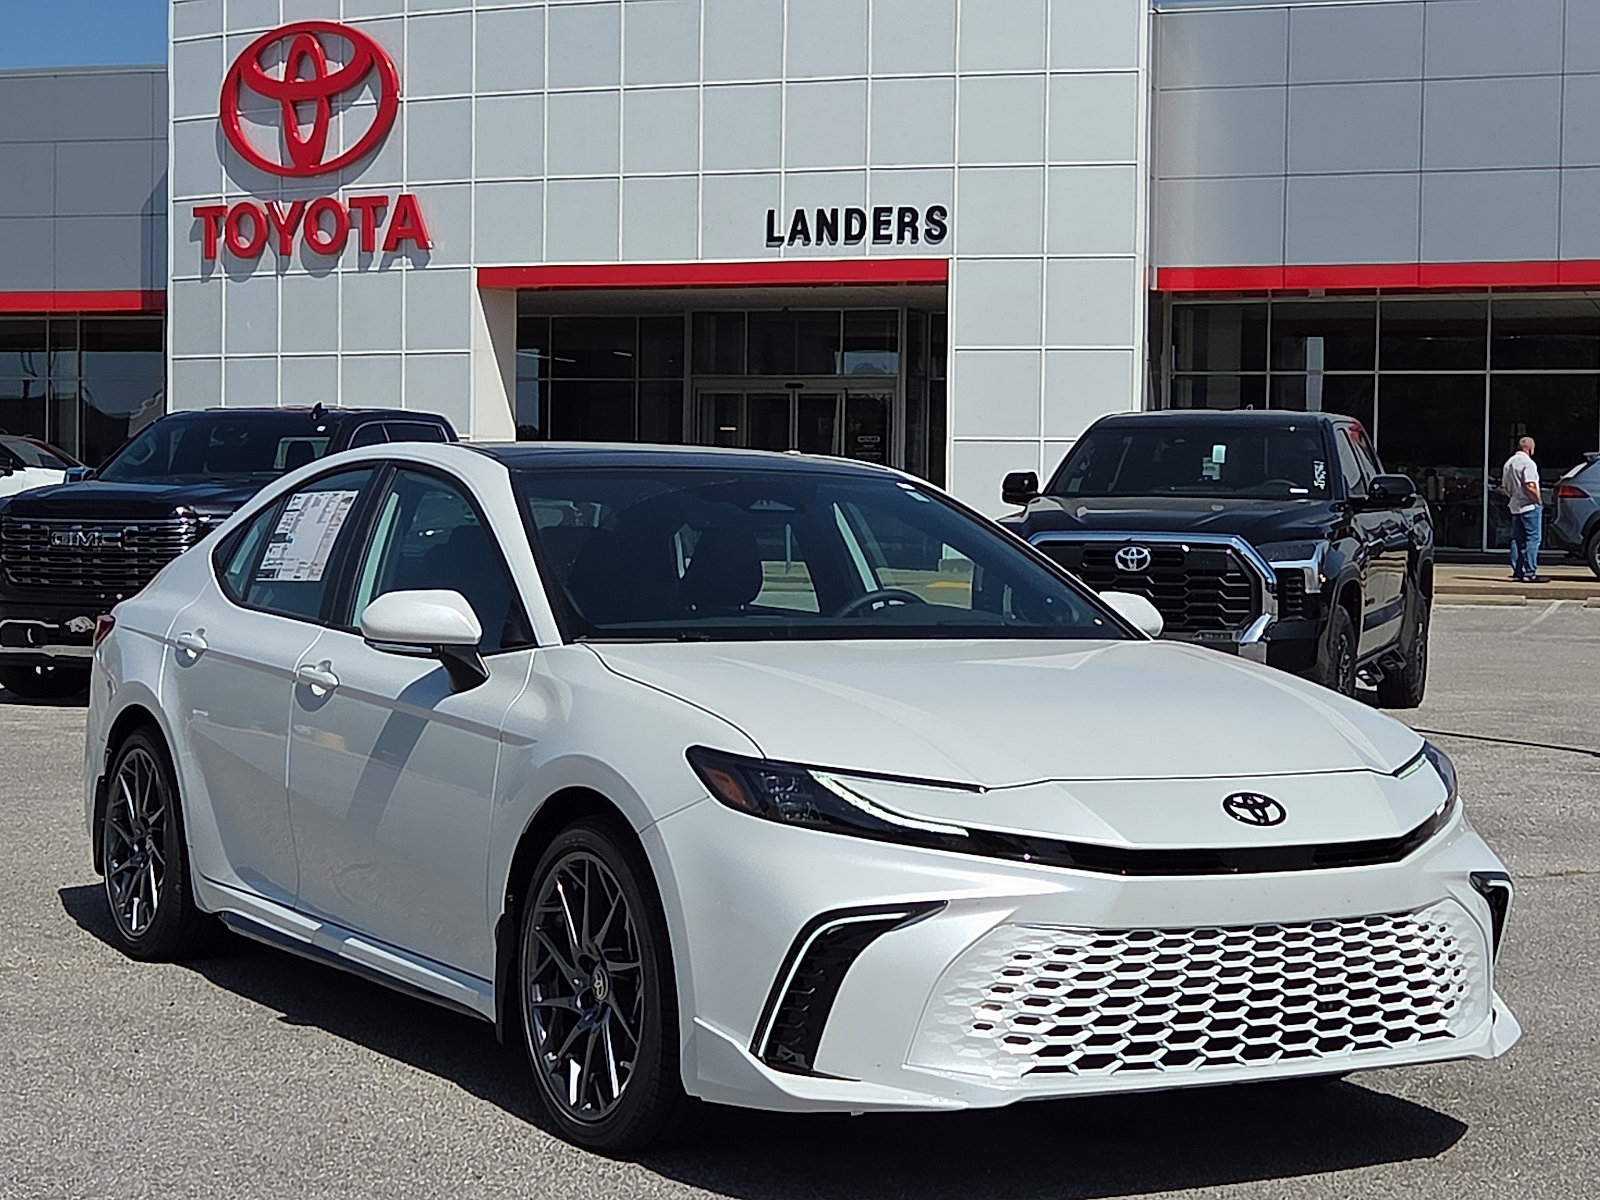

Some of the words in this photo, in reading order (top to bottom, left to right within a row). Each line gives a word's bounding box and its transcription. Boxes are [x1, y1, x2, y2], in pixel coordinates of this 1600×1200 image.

[193, 194, 433, 260] TOYOTA
[766, 205, 948, 247] LANDERS
[50, 531, 122, 548] GMC
